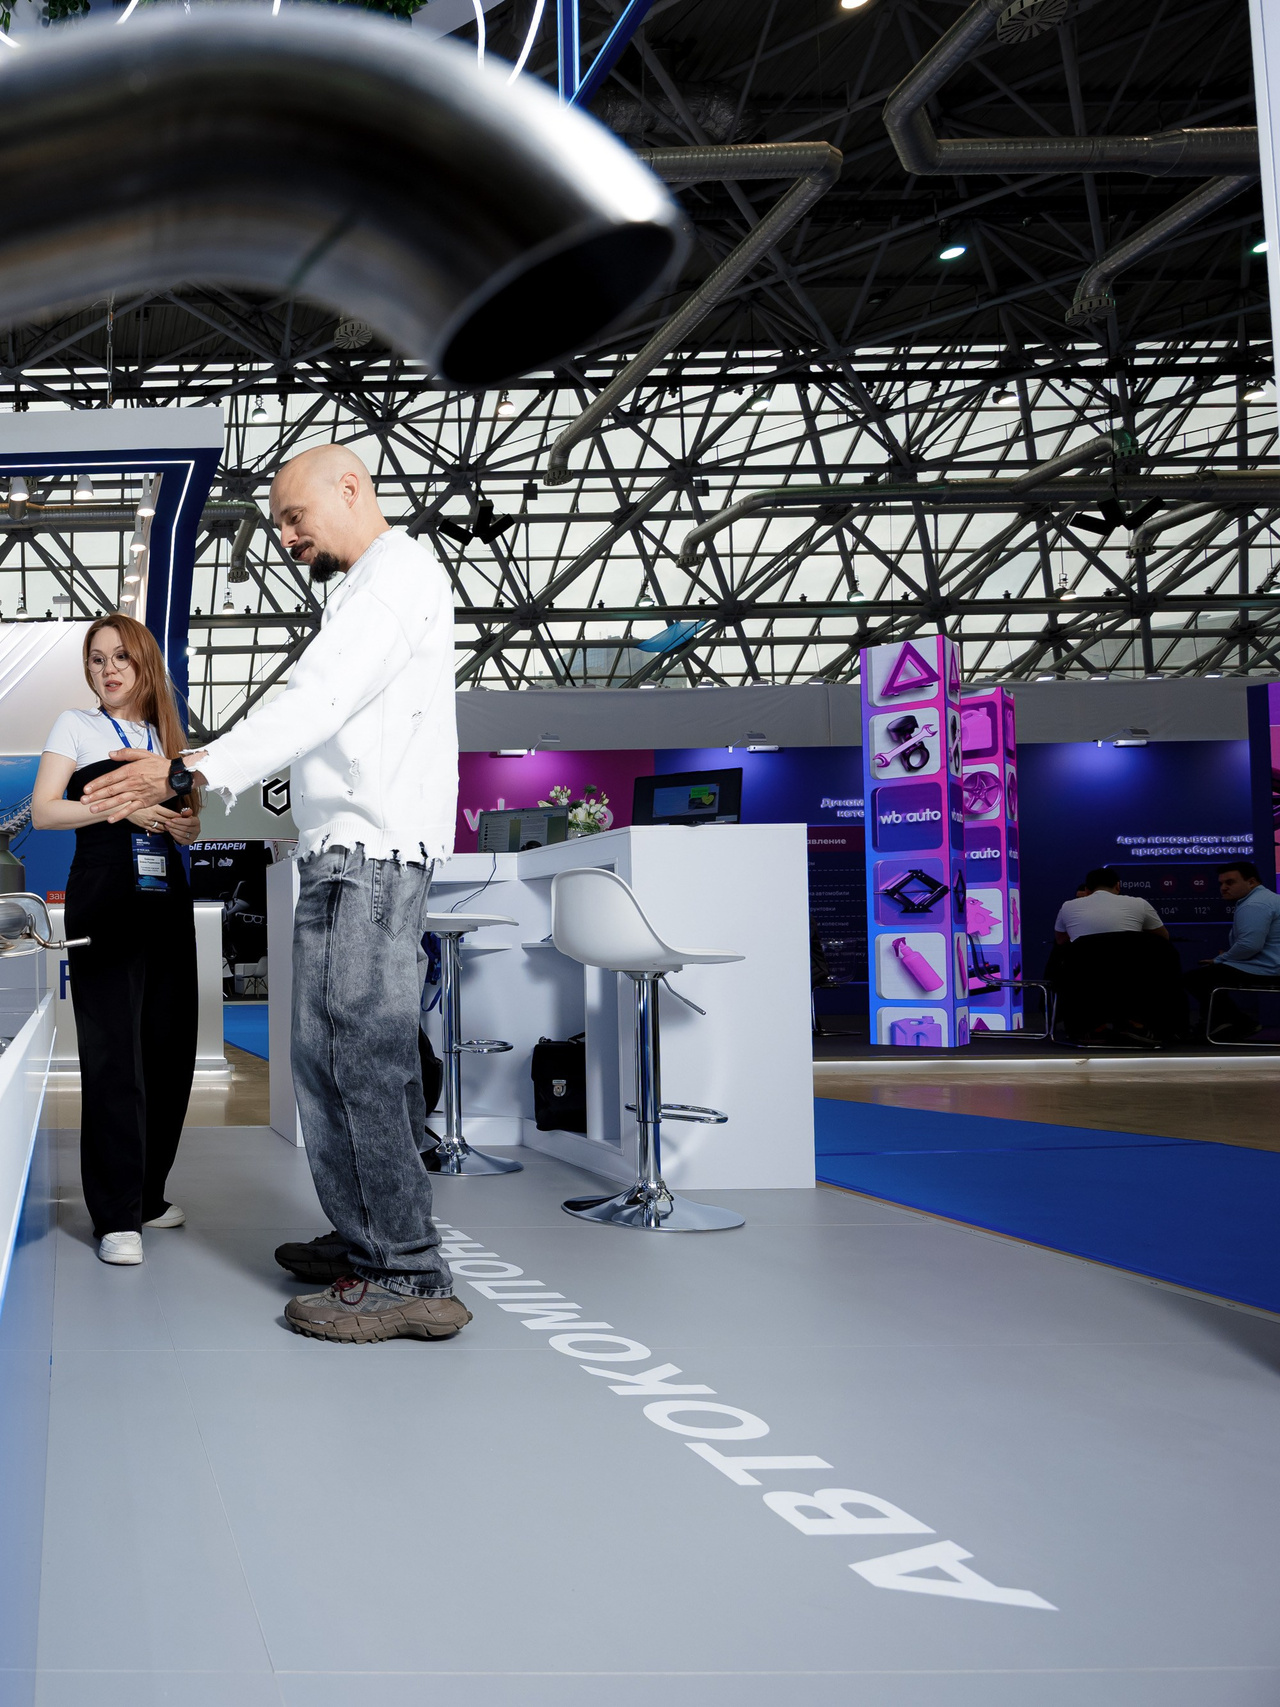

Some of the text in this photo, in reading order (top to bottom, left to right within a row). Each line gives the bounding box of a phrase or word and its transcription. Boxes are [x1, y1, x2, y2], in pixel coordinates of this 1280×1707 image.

[880, 808, 942, 825] wb auto
[204, 842, 247, 851] БАТАРЕИ
[970, 847, 1001, 860] auto
[431, 1216, 1059, 1611] АВТОКОМПОН
